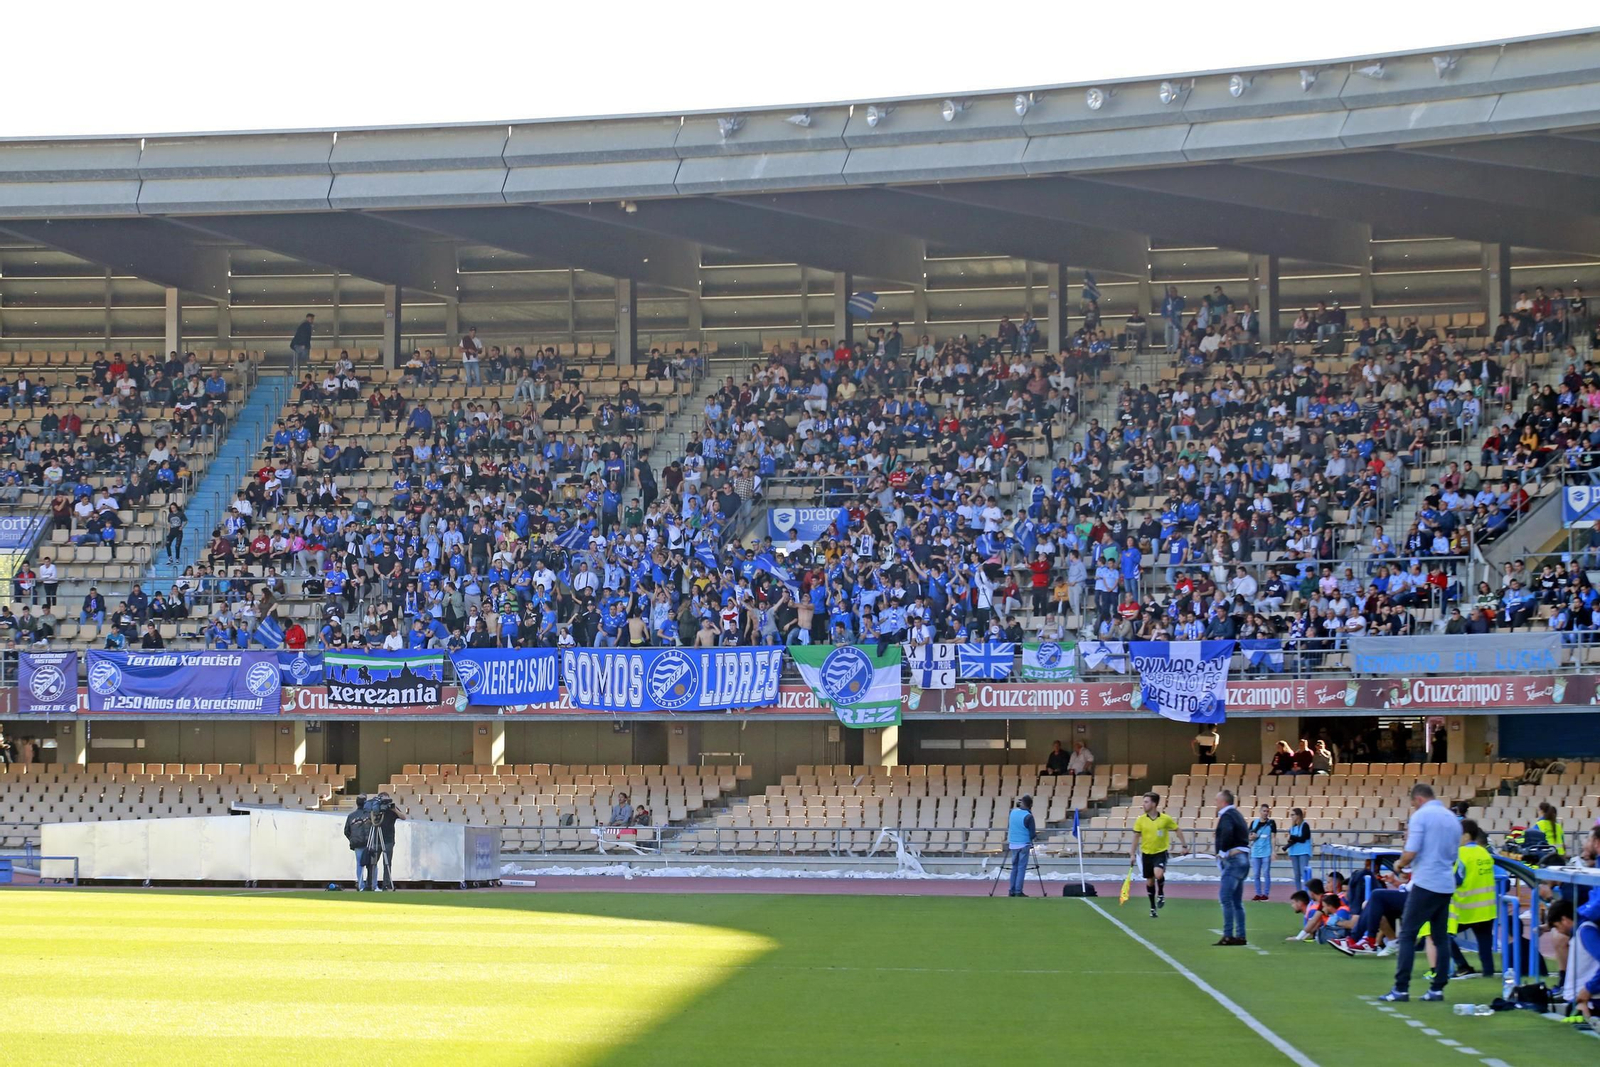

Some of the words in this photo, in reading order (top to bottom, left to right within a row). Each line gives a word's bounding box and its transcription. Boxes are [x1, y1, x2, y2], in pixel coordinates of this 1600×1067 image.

[126, 655, 176, 666] Tertulia
[179, 654, 242, 666] Xerecista
[1454, 650, 1478, 672] EN
[1495, 648, 1558, 670] LUCHA
[481, 656, 555, 695] XERECISMO
[564, 650, 644, 708] SOMOS
[699, 649, 783, 706] LIBRES
[1024, 668, 1073, 679] XEREZ
[143, 696, 174, 709] Años
[175, 697, 191, 709] de
[192, 697, 263, 710] Xerecismo!!
[980, 685, 1074, 710] Cruzcampo
[1149, 683, 1198, 713] DELITO
[1412, 680, 1501, 706] Cruzcampo
[1506, 683, 1514, 701] SIN
[836, 706, 898, 724] REZ
